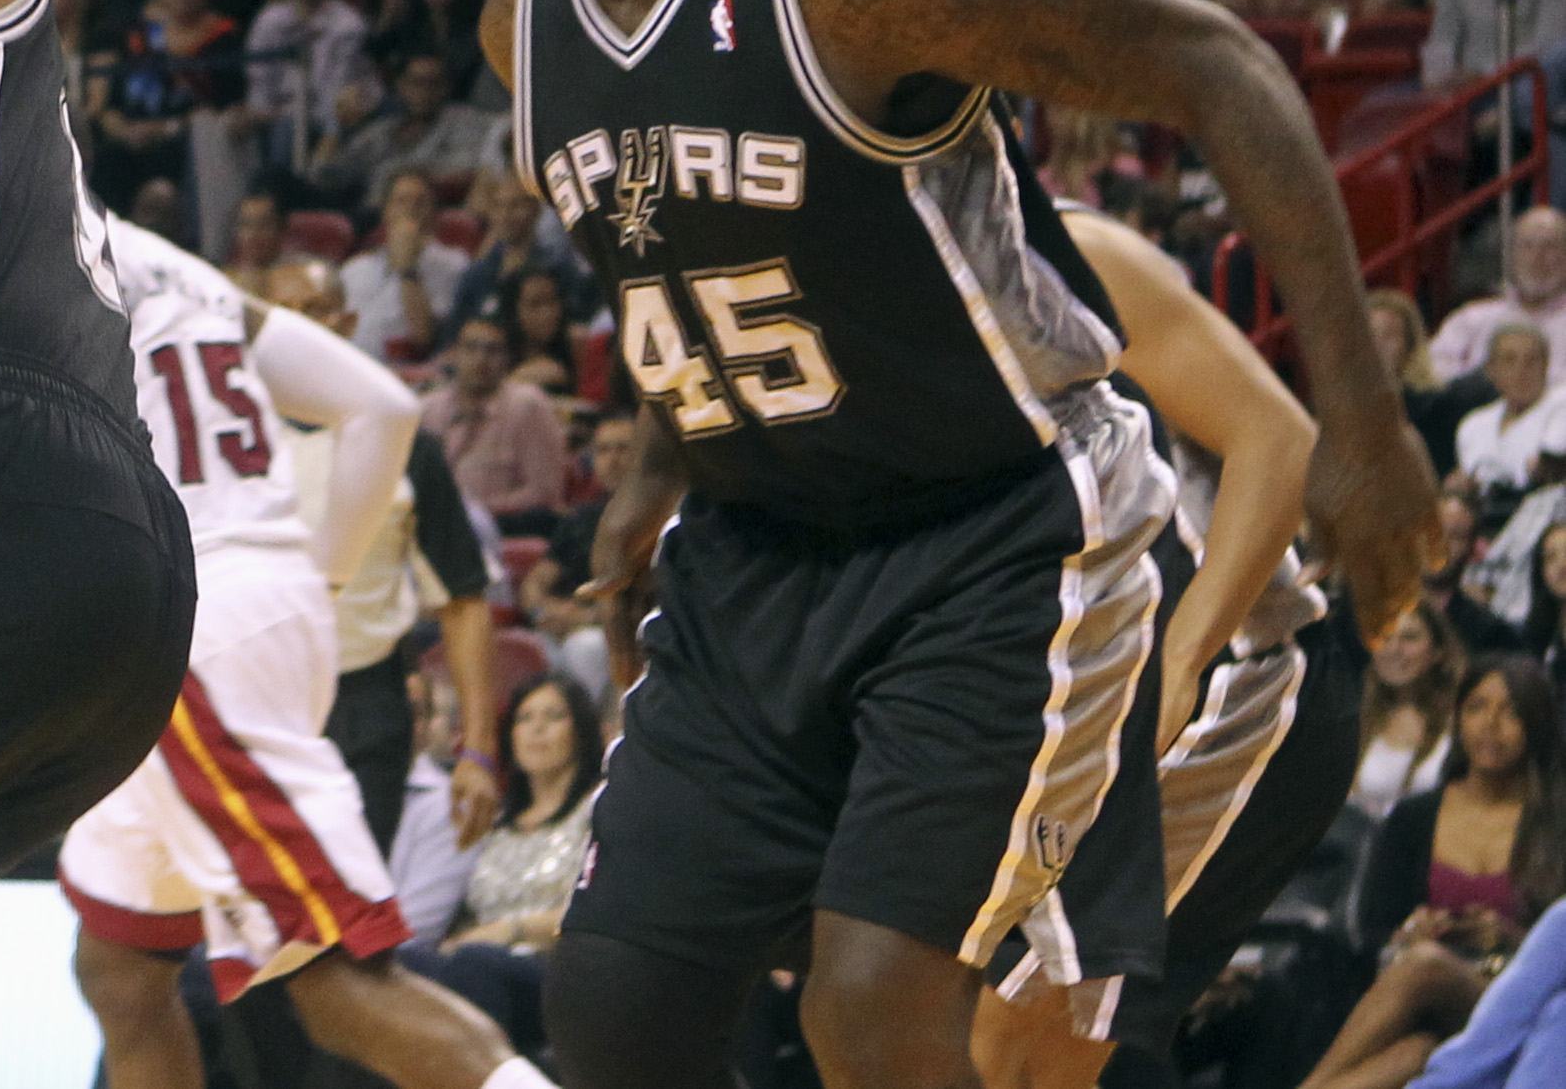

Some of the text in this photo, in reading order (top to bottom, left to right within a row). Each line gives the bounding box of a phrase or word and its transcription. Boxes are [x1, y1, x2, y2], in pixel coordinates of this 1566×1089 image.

[541, 124, 807, 257] SPURS
[150, 340, 272, 485] 15
[619, 255, 848, 441] 45
